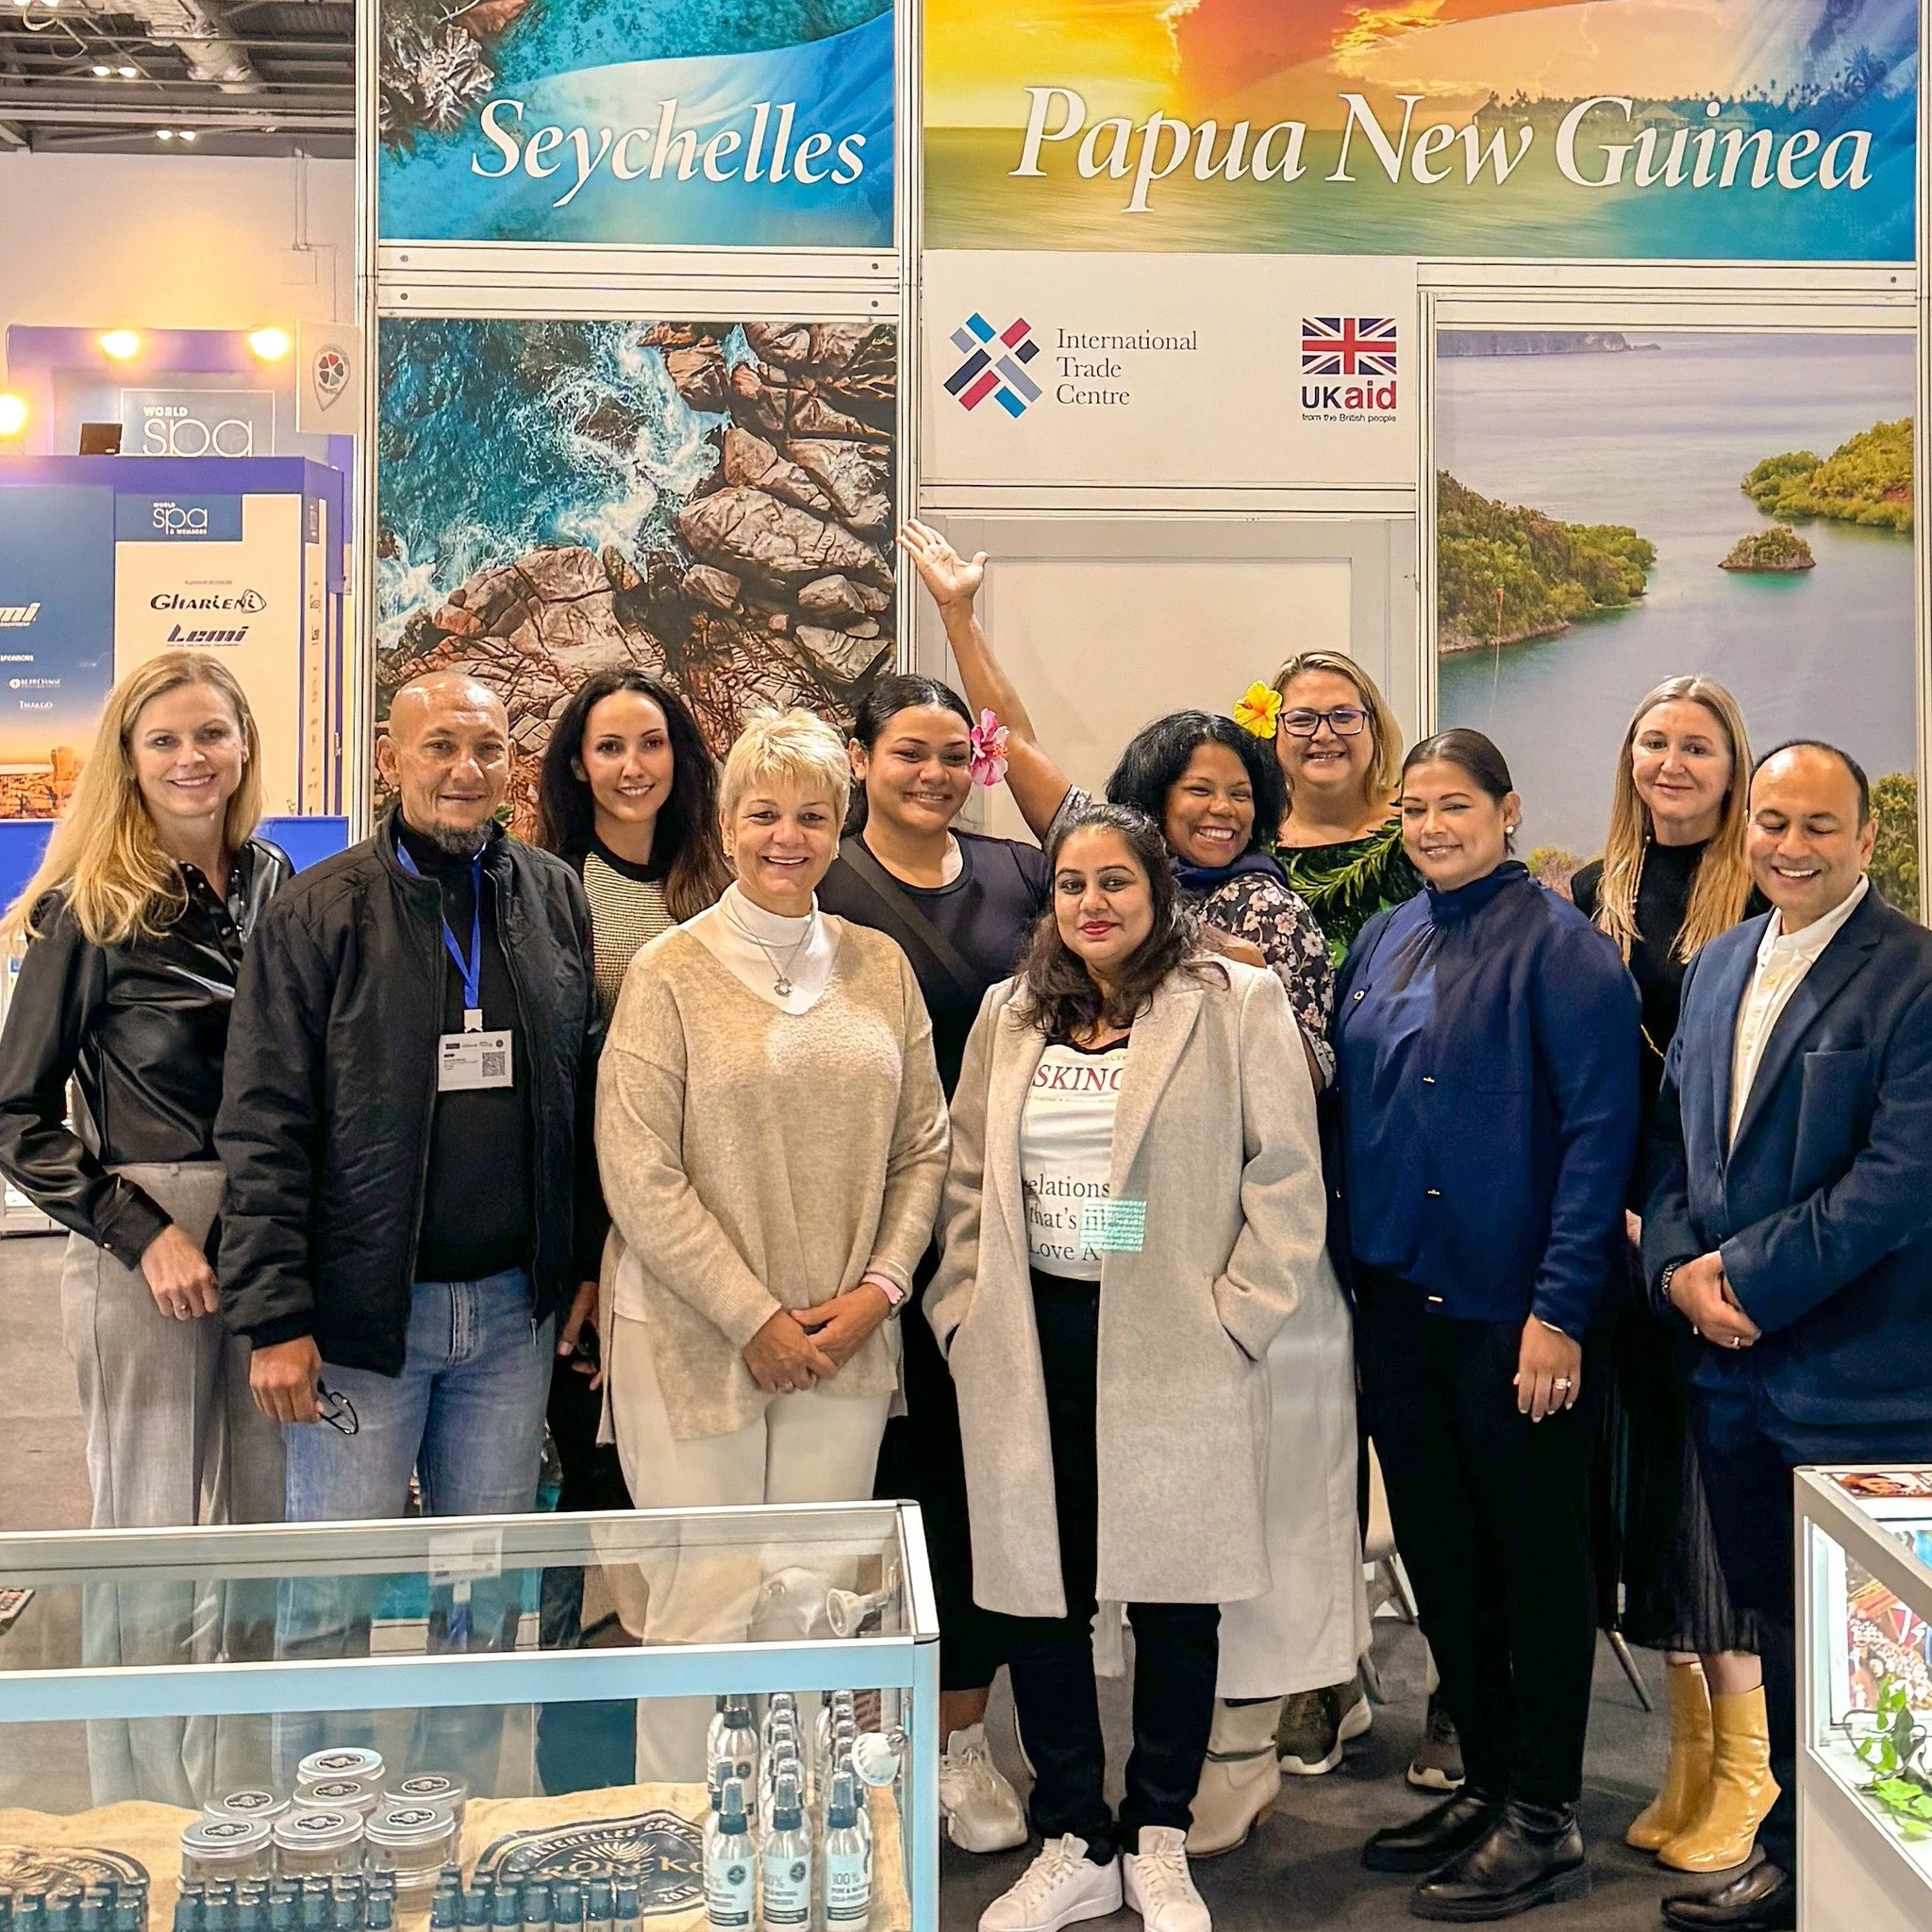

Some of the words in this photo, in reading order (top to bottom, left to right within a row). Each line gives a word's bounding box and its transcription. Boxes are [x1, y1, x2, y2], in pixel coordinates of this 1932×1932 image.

[471, 98, 867, 208] Seychelles
[1008, 86, 1307, 213] Papua
[1324, 93, 1534, 186] New
[1555, 95, 1873, 190] Guinea
[1057, 327, 1198, 350] International
[1057, 356, 1122, 377] Trade
[1056, 383, 1130, 405] Centre
[143, 406, 189, 417] WORLD
[1302, 413, 1321, 422] from
[1324, 413, 1337, 422] the
[1339, 413, 1366, 422] British
[1368, 415, 1396, 424] people
[142, 418, 253, 458] spa
[152, 508, 208, 535] spa
[167, 624, 249, 642] Lemi
[1029, 1232, 1074, 1261] Love
